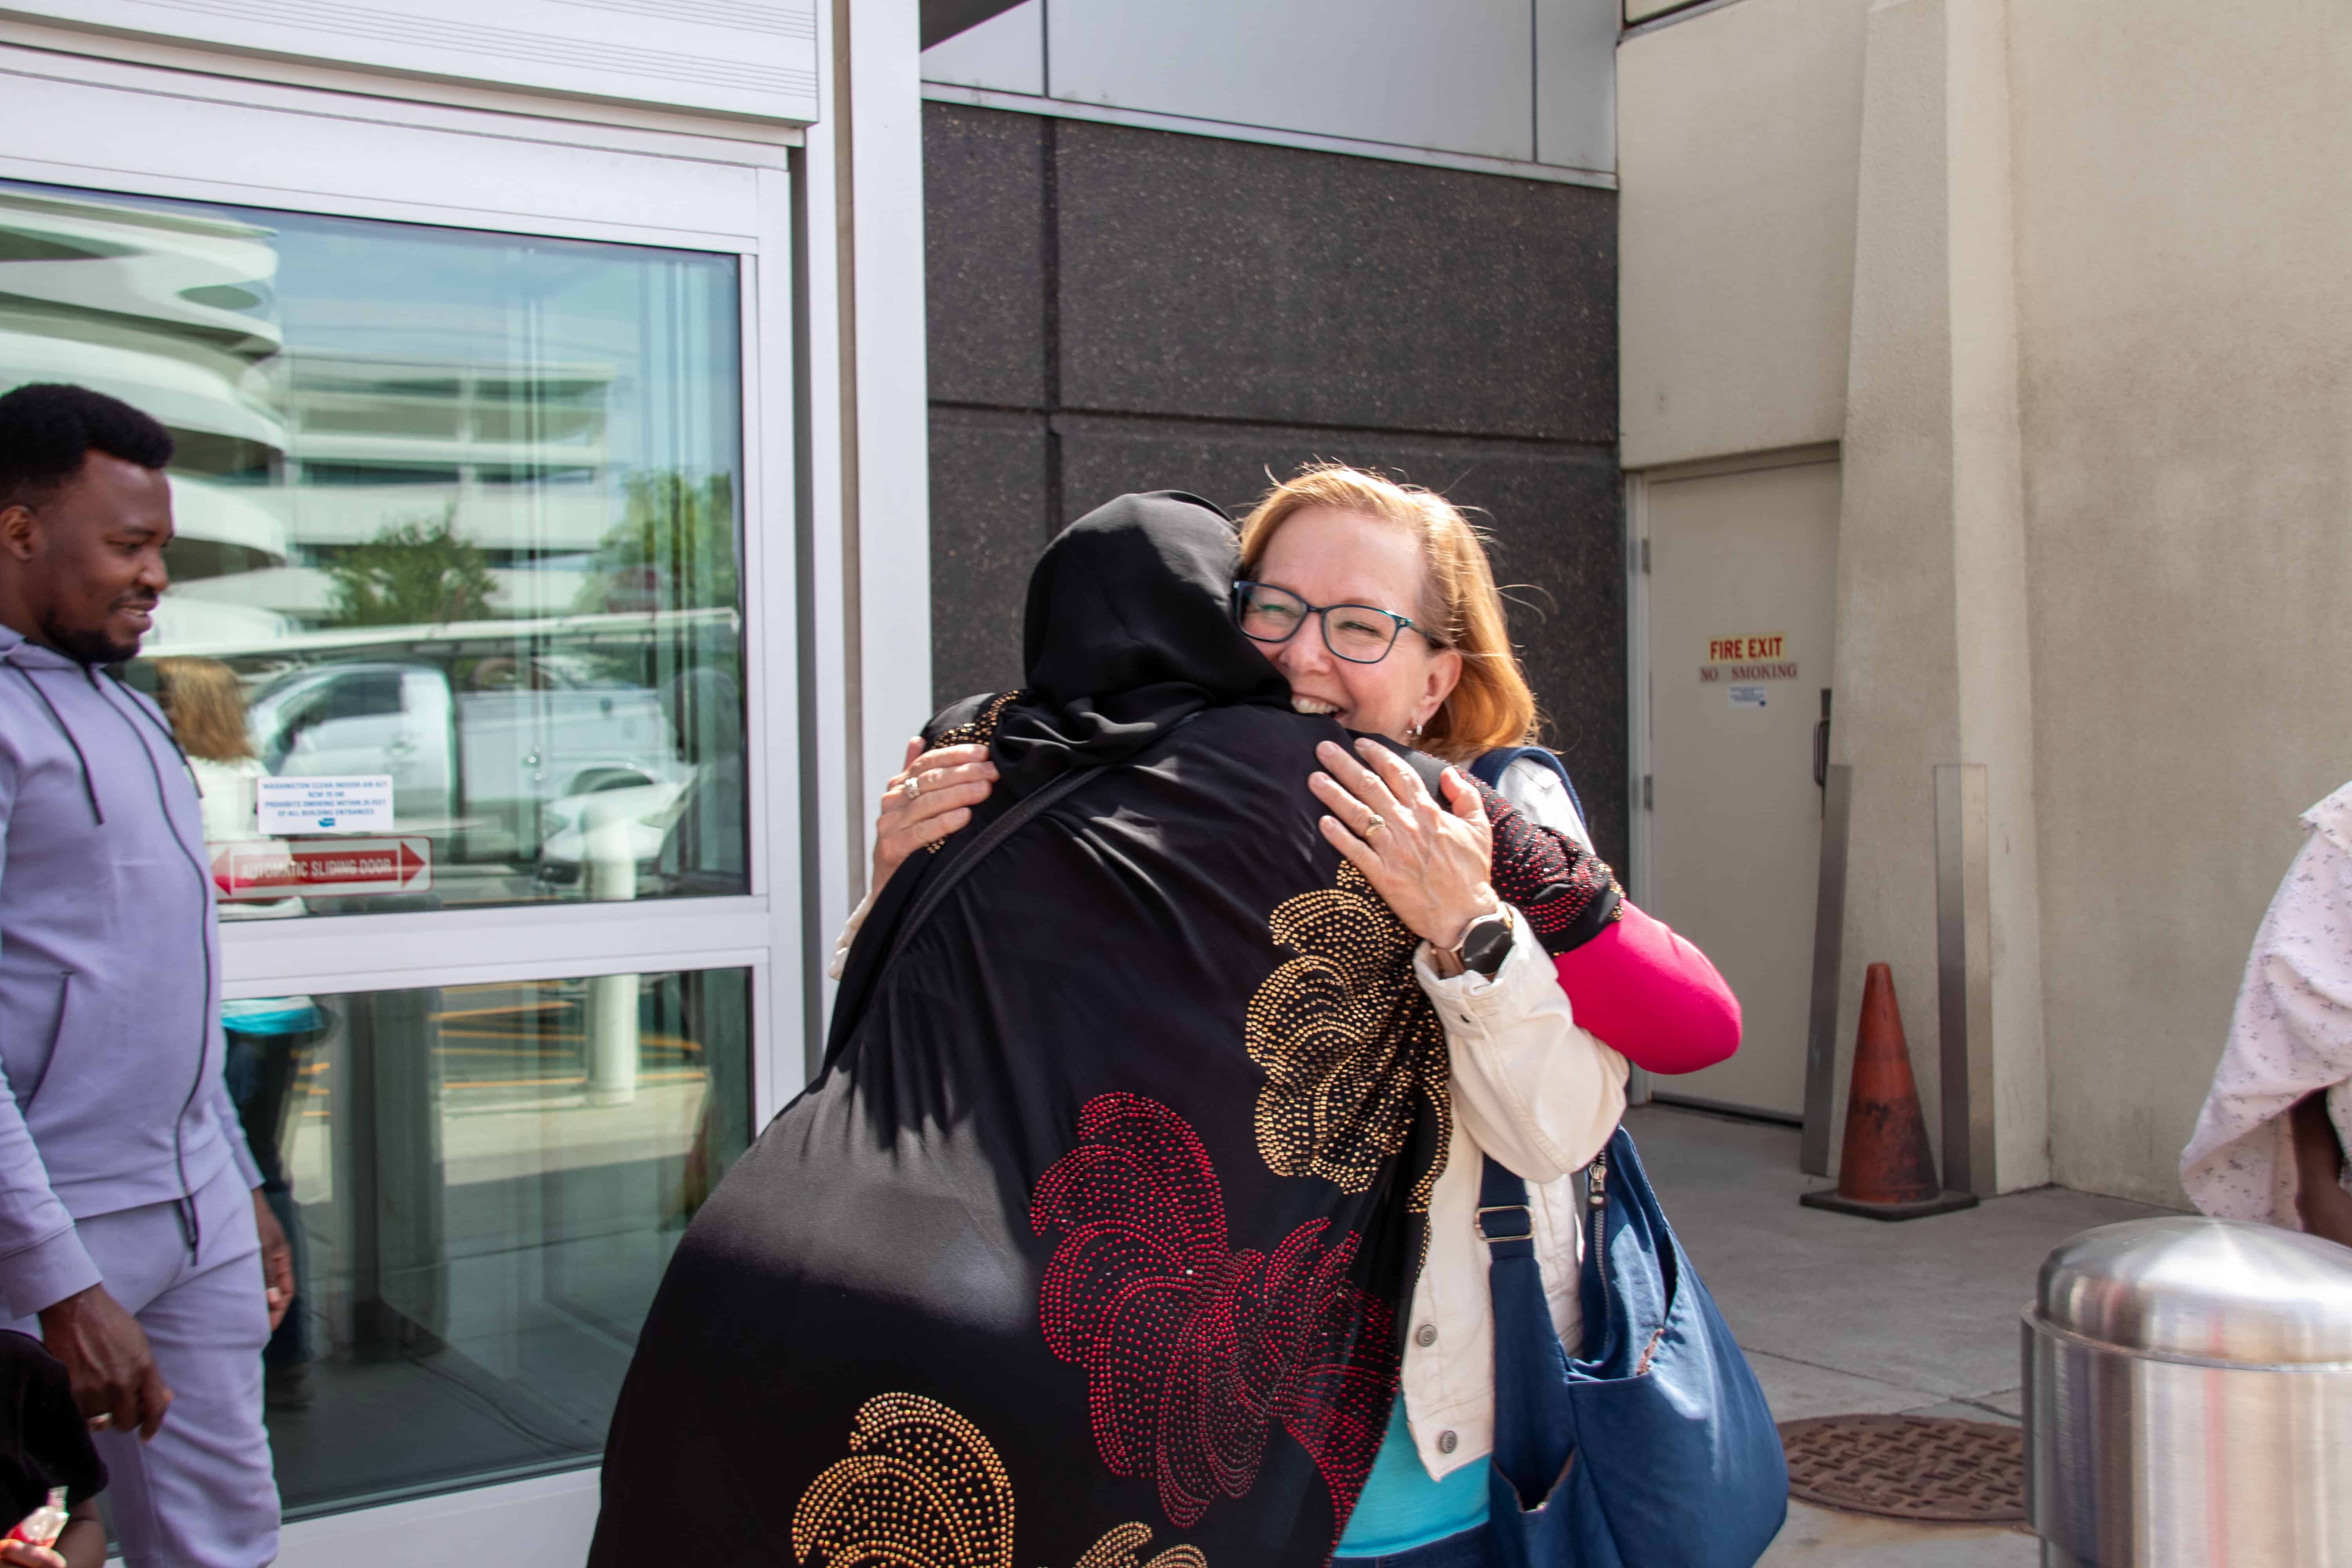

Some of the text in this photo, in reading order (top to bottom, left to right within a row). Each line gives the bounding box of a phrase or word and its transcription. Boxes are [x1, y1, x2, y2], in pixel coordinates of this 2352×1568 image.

[1710, 636, 1782, 661] FIRE EXIT
[1700, 663, 1797, 682] NO SMOKING
[241, 857, 392, 879] AUTOMATIC SLIDING DOOR
